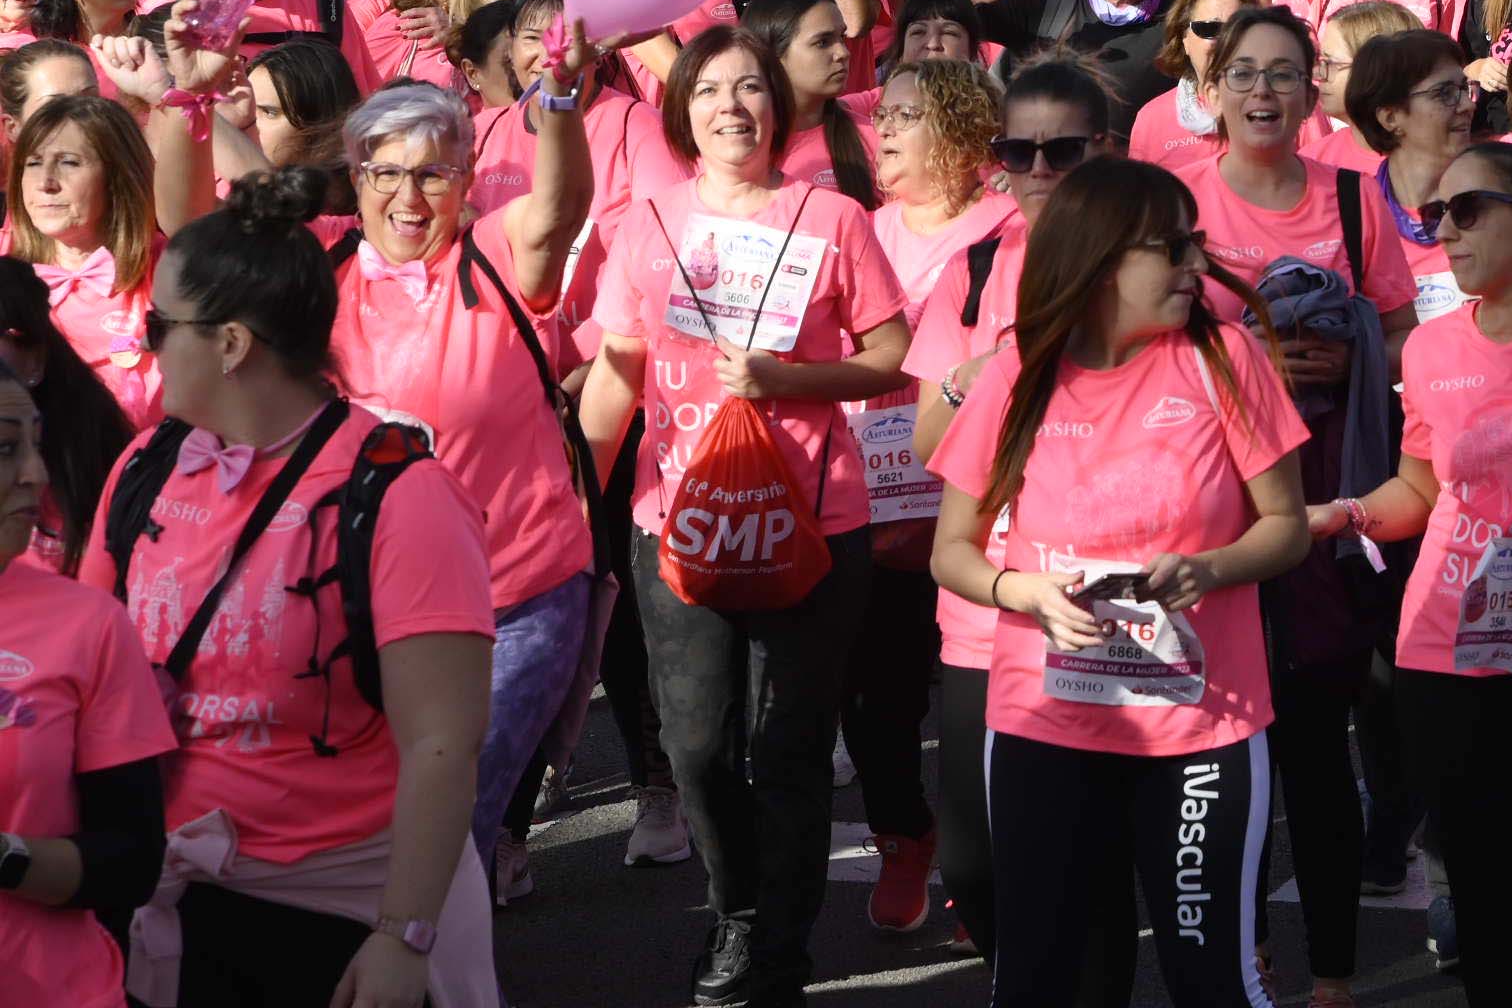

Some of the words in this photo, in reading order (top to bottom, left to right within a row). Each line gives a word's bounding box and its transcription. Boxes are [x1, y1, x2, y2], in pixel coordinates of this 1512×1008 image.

[721, 269, 765, 290] 016
[1430, 374, 1485, 392] OYSHO
[1036, 421, 1095, 438] YSHO
[868, 449, 912, 470] 016
[877, 472, 903, 484] 5621
[667, 507, 796, 562] SMP
[1101, 618, 1155, 641] 016
[1108, 644, 1143, 660] 6868
[1060, 659, 1104, 672] CARRERA
[1106, 664, 1119, 673] DE
[1122, 664, 1135, 674] LA
[1136, 666, 1167, 674] MUJER
[1055, 677, 1104, 694] OYSHO
[1177, 763, 1219, 947] iVascular
